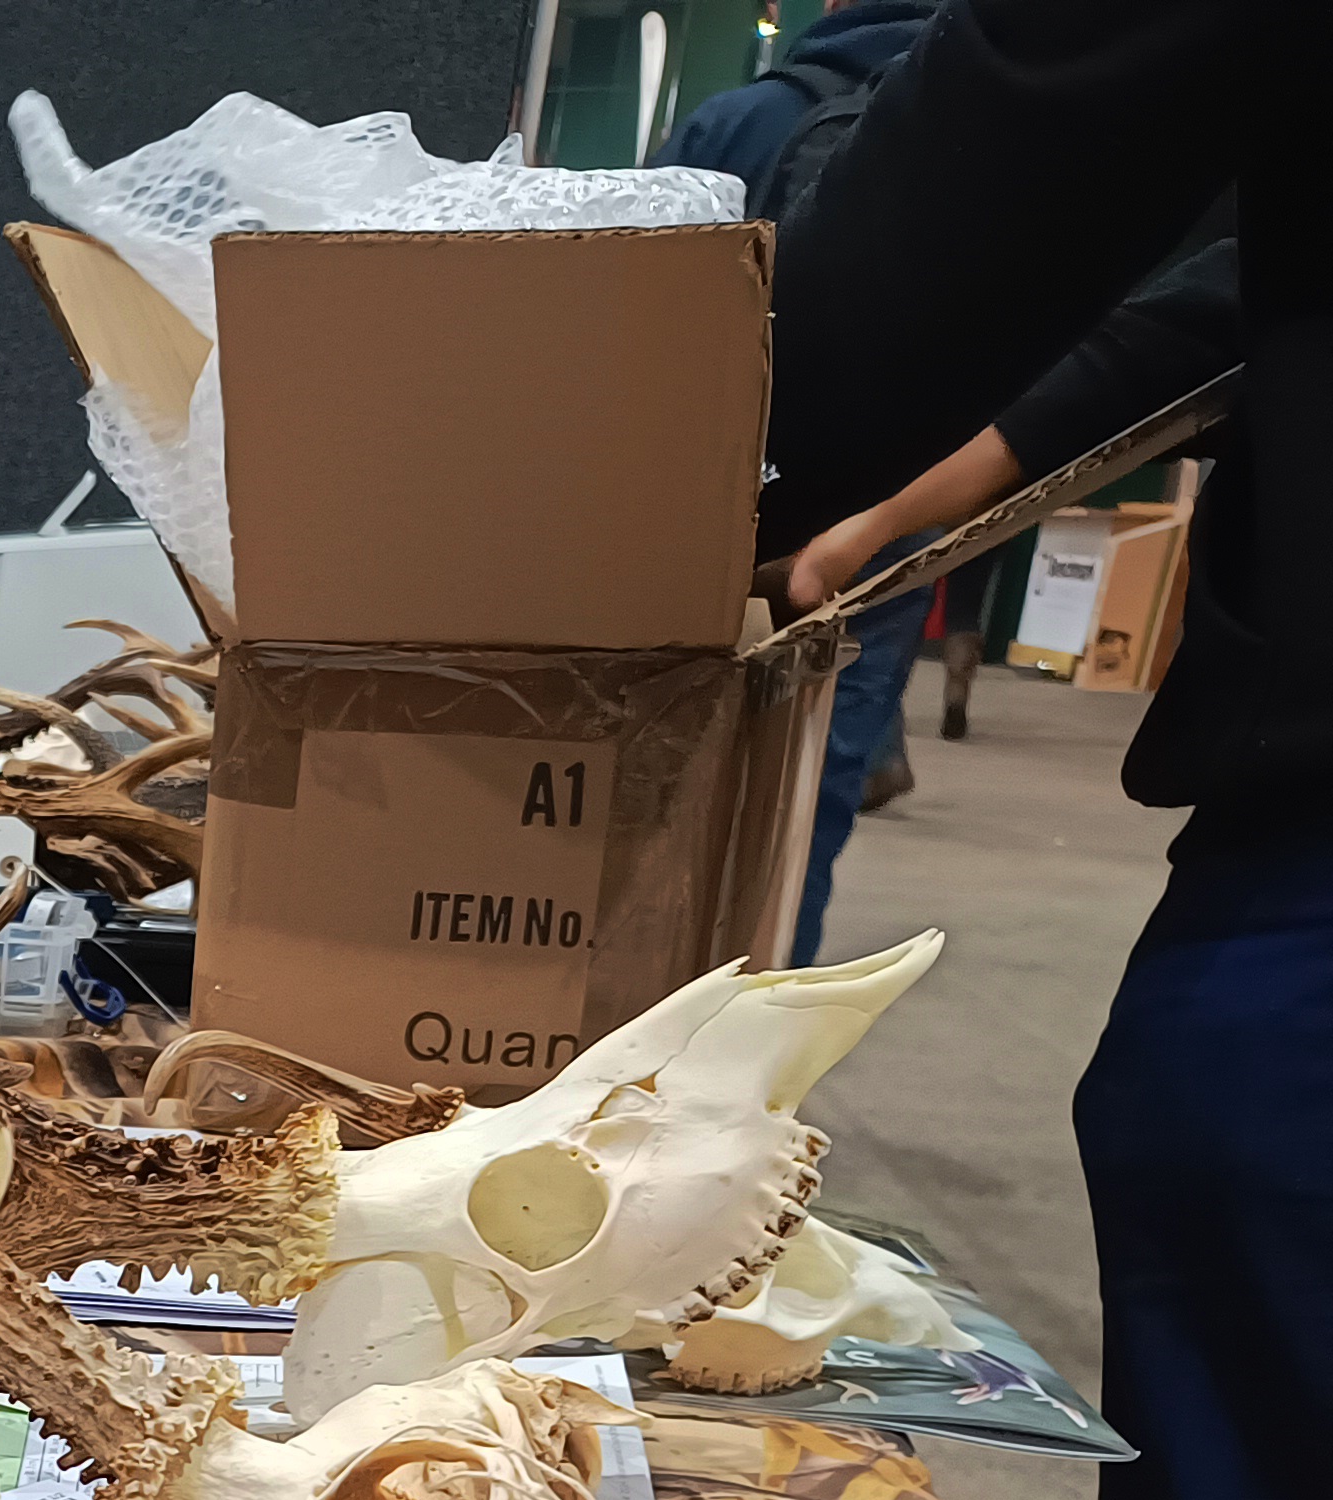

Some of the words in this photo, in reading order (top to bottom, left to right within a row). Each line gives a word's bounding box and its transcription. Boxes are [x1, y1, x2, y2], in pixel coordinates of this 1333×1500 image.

[521, 761, 585, 828] A1
[411, 891, 511, 944] ITEM
[524, 898, 595, 949] No.
